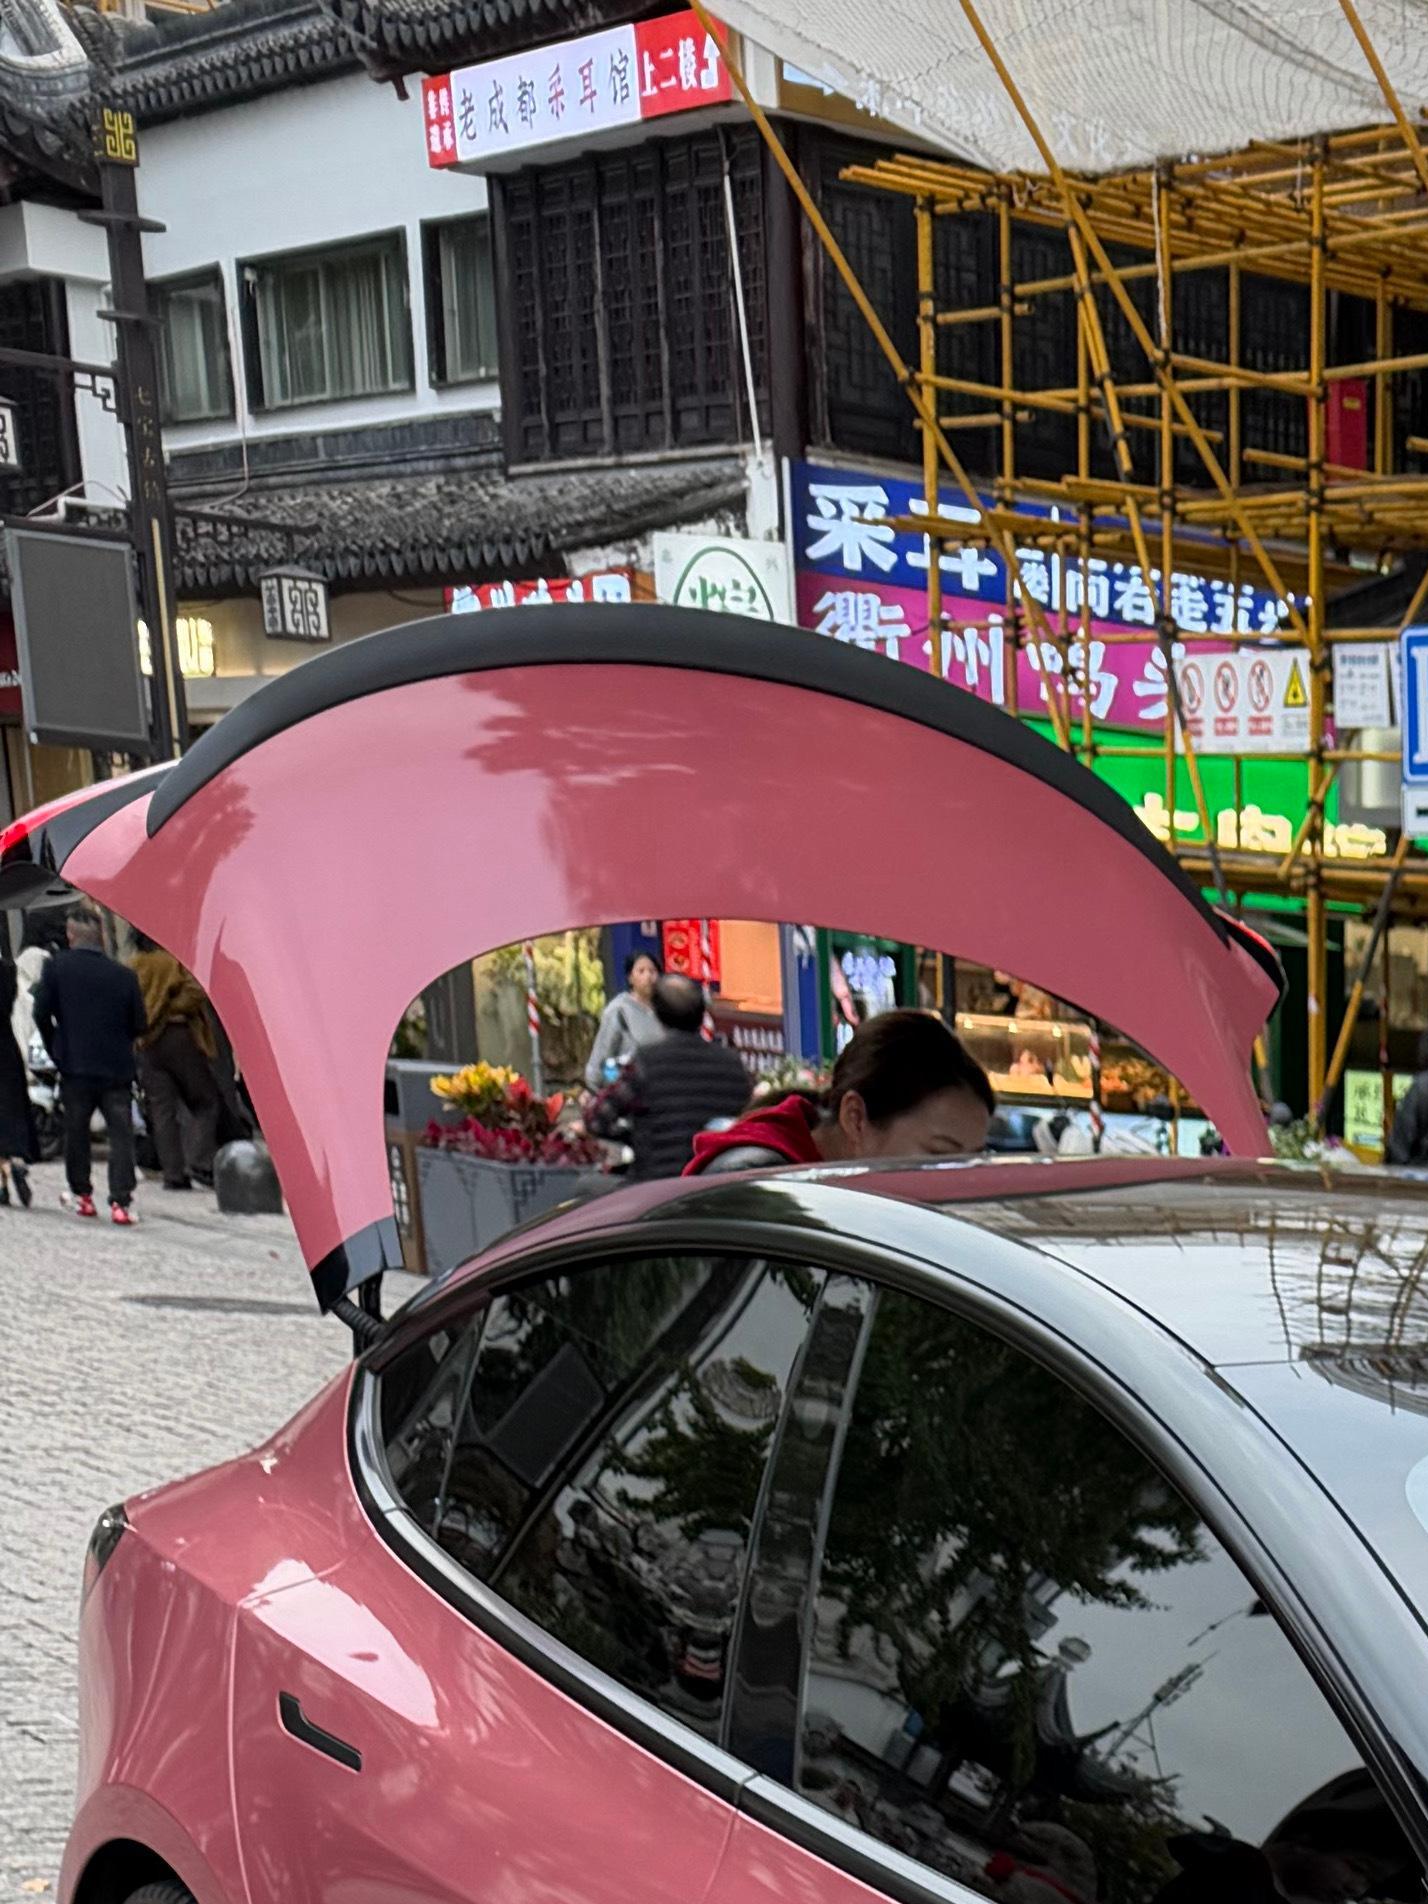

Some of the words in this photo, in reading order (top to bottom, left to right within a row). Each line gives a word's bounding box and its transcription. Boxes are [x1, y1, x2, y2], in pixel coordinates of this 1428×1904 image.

[458, 47, 632, 142] 老成都采耳馆
